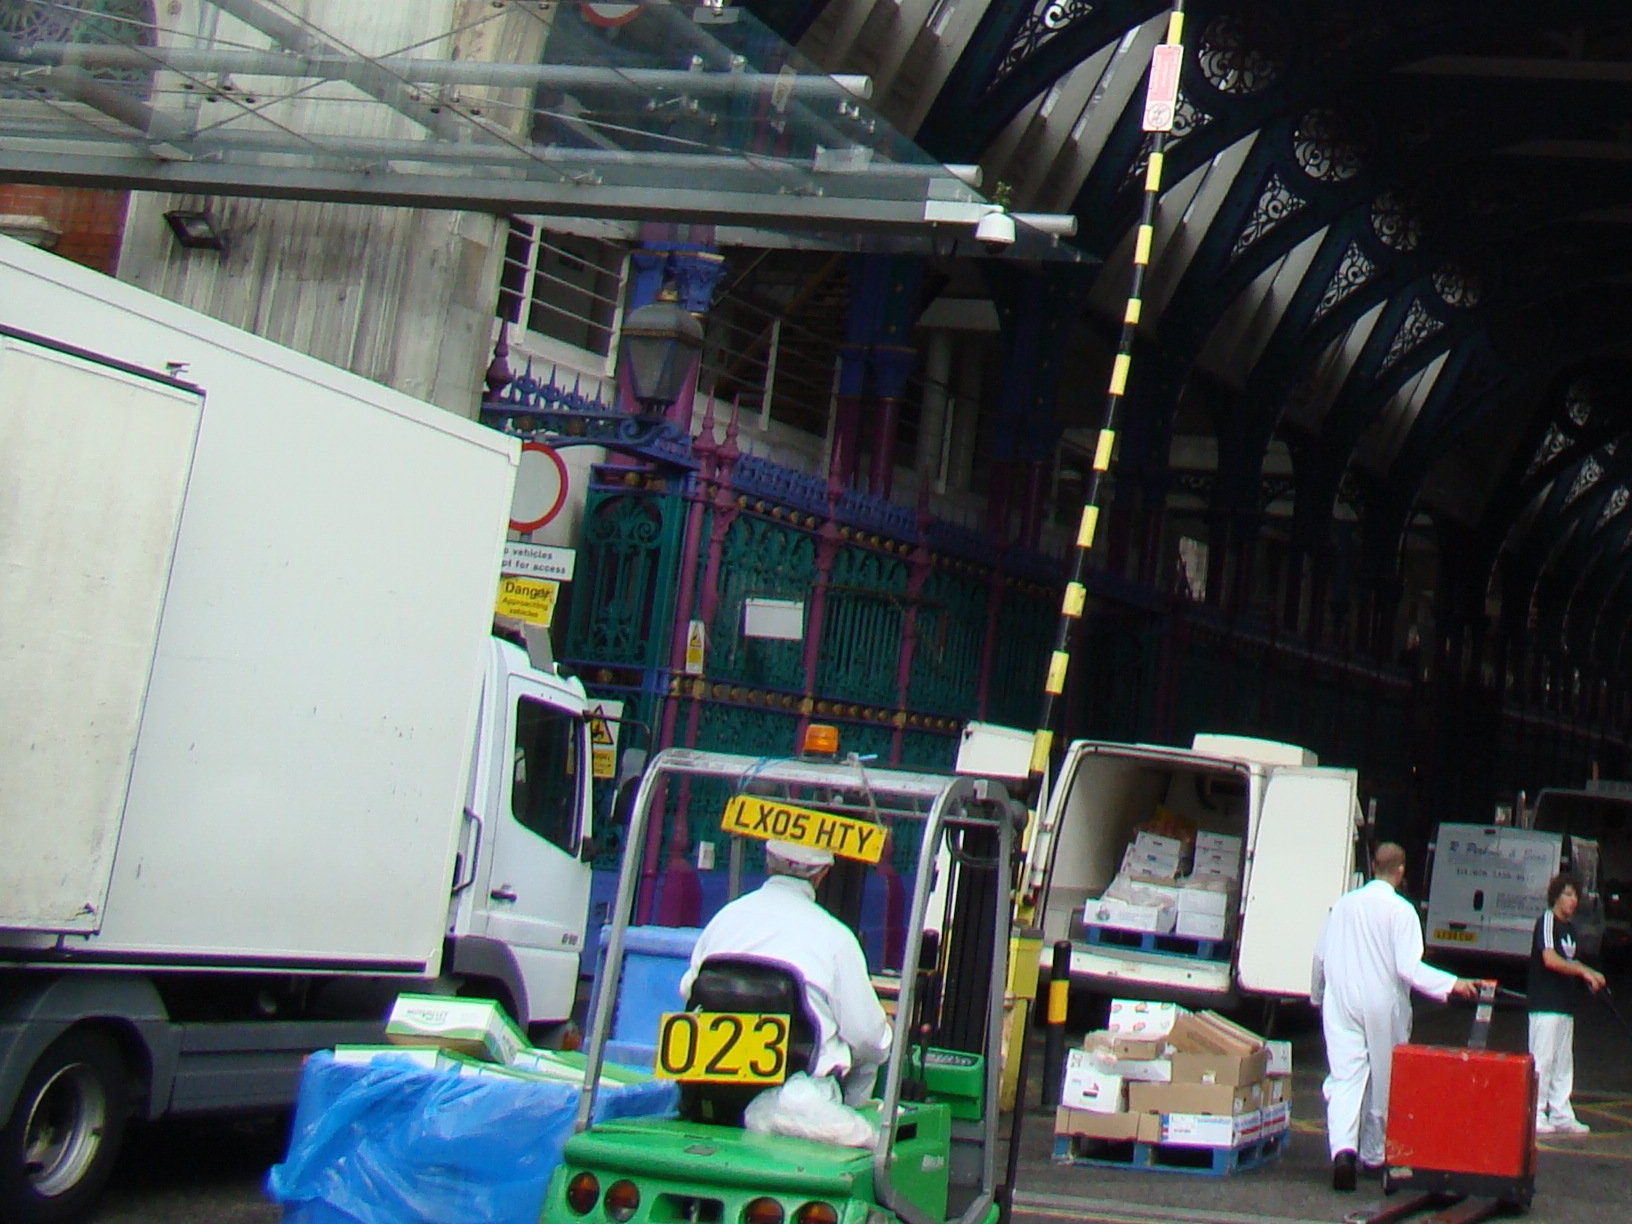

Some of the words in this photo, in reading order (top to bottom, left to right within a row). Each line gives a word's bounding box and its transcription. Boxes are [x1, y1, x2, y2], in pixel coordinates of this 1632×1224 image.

[513, 549, 552, 560] vehicles
[516, 560, 529, 569] for
[533, 564, 566, 574] access
[505, 581, 551, 600] Danger
[734, 801, 810, 840] LX05
[815, 818, 874, 854] HTY
[660, 1013, 786, 1077] 023
